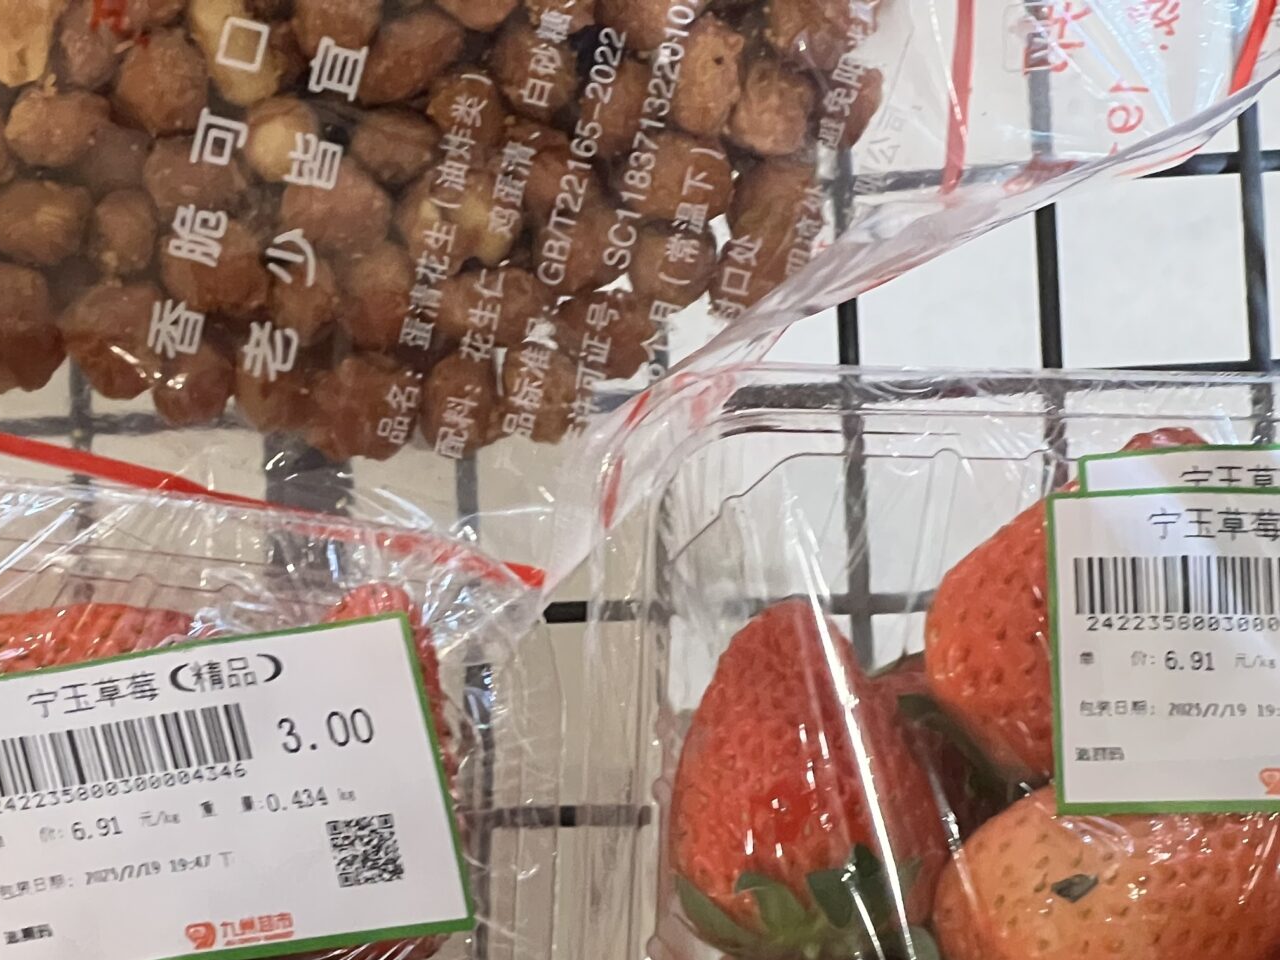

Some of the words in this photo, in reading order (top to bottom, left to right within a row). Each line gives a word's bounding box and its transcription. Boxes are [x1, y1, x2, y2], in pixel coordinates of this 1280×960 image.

[147, 17, 269, 359] 香脆可口
[243, 36, 369, 381] 老少皆宜
[1147, 507, 1280, 542] 宁玉草莓
[1164, 650, 1215, 672] 6.91
[277, 706, 375, 754] 3.00
[70, 815, 123, 841] 6.91
[265, 786, 329, 812] 0.434
